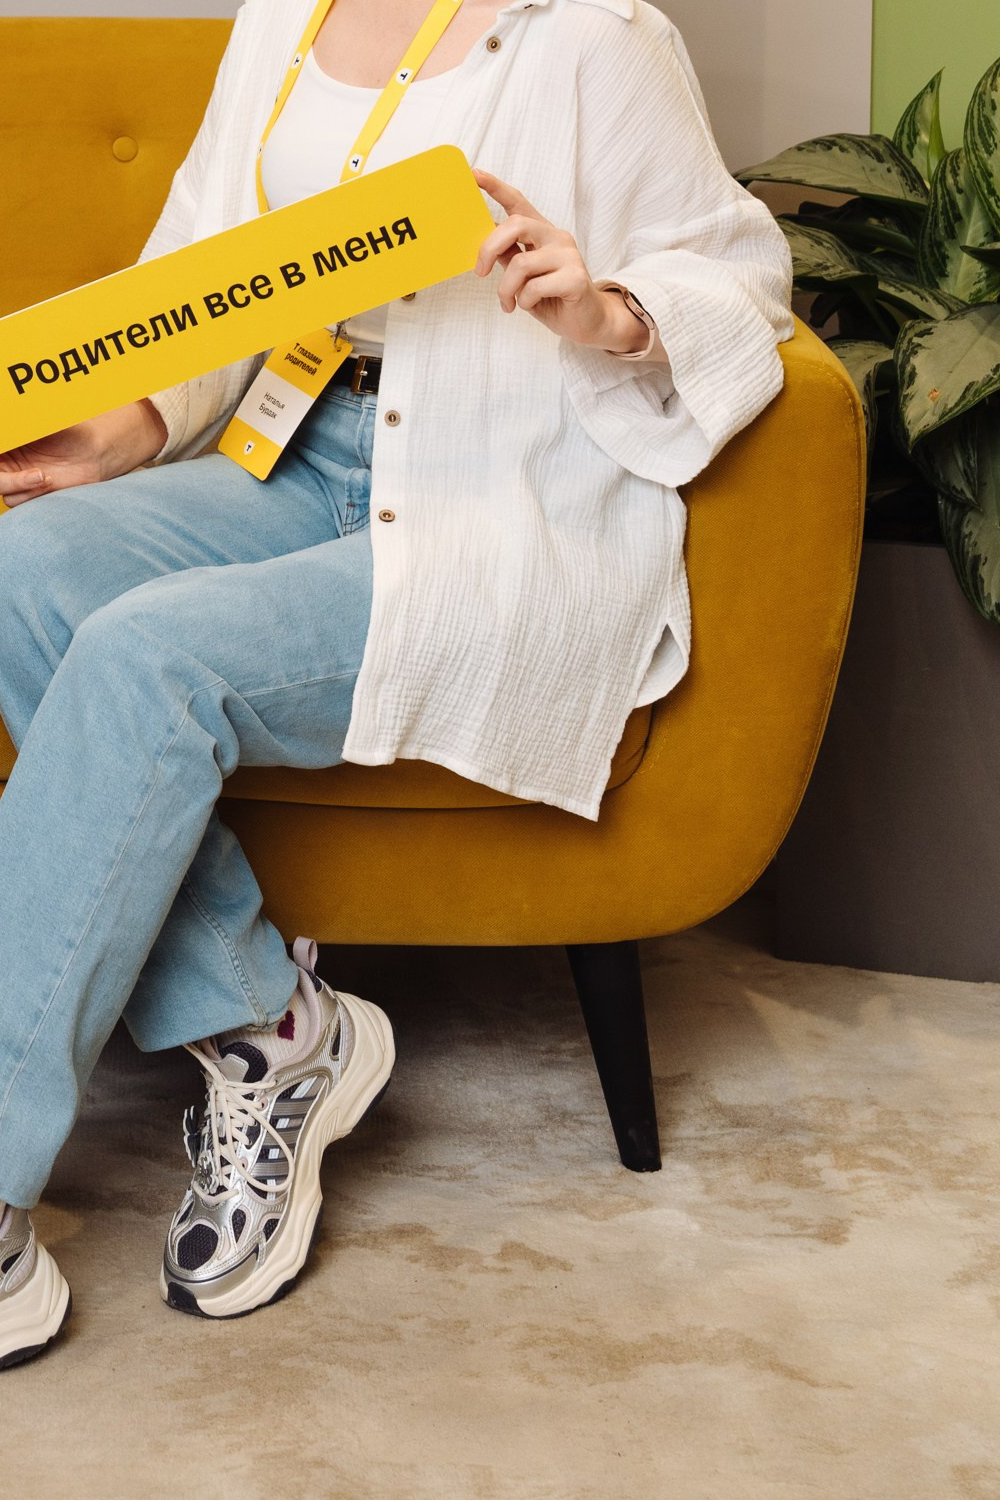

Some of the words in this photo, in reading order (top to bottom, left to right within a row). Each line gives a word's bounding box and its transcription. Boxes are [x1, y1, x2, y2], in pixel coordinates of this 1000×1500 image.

[6, 303, 199, 395] Родители
[202, 273, 274, 319] все
[279, 261, 306, 289] в
[312, 216, 418, 277] меня
[293, 342, 300, 351] Т
[296, 345, 323, 366] глазами
[284, 353, 318, 376] родителей
[258, 402, 278, 419] Бурдак
[263, 392, 286, 410] Наталья
